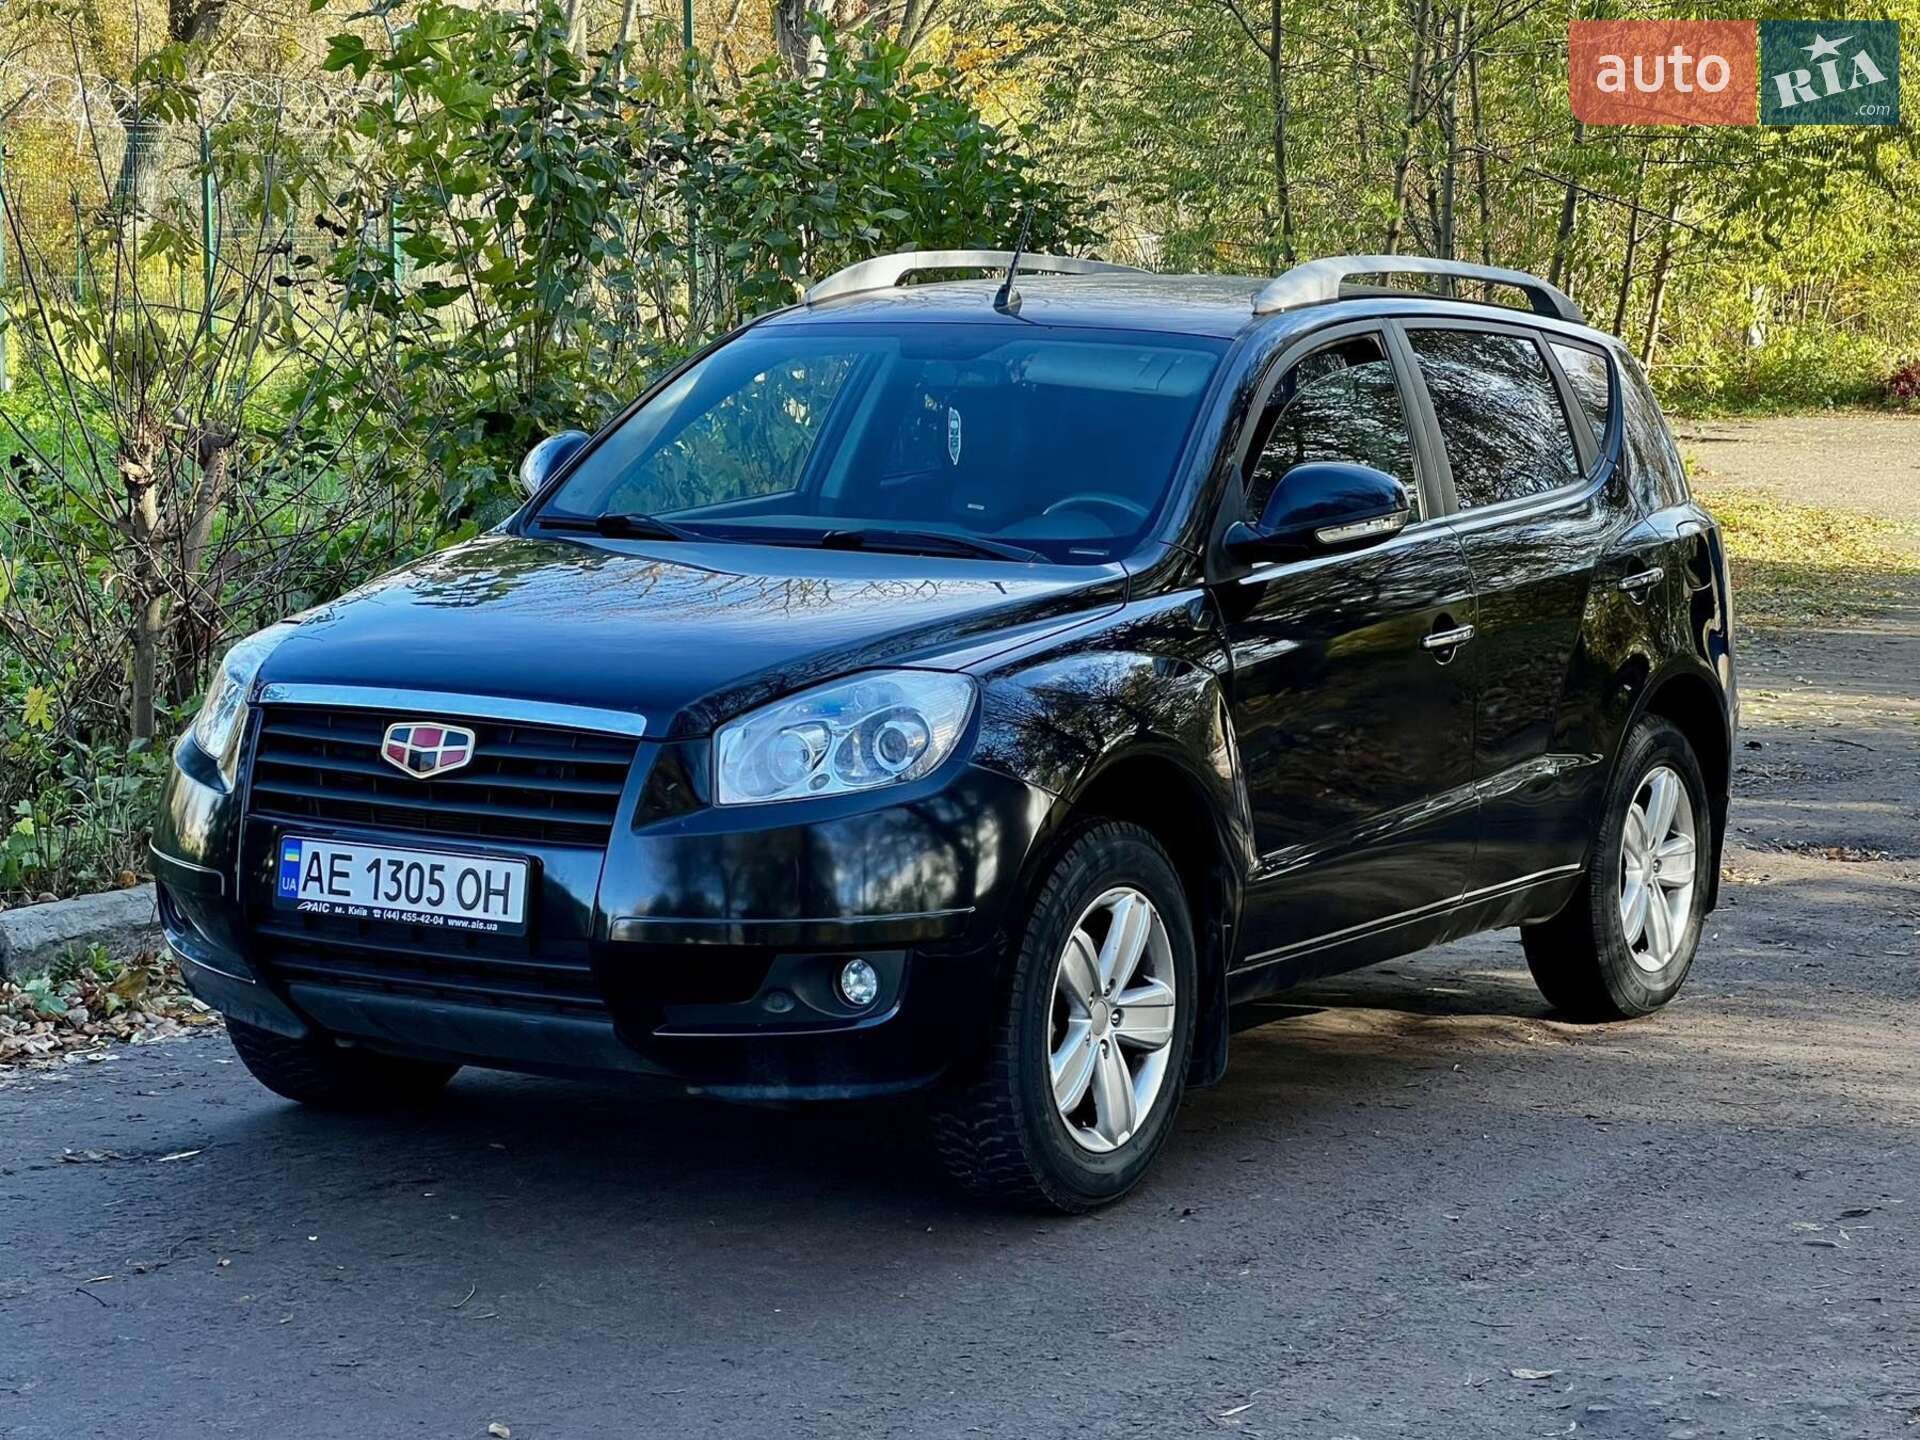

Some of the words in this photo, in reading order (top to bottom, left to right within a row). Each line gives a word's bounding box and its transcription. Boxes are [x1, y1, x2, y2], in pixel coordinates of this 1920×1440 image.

[281, 876, 297, 891] UA
[302, 851, 353, 897] AE
[366, 857, 445, 907] 1305
[456, 867, 511, 915] OH
[348, 905, 368, 917] Київ
[383, 909, 400, 921] (44)
[401, 911, 444, 925] 455-42-04
[448, 918, 499, 931] www.ais.ua
